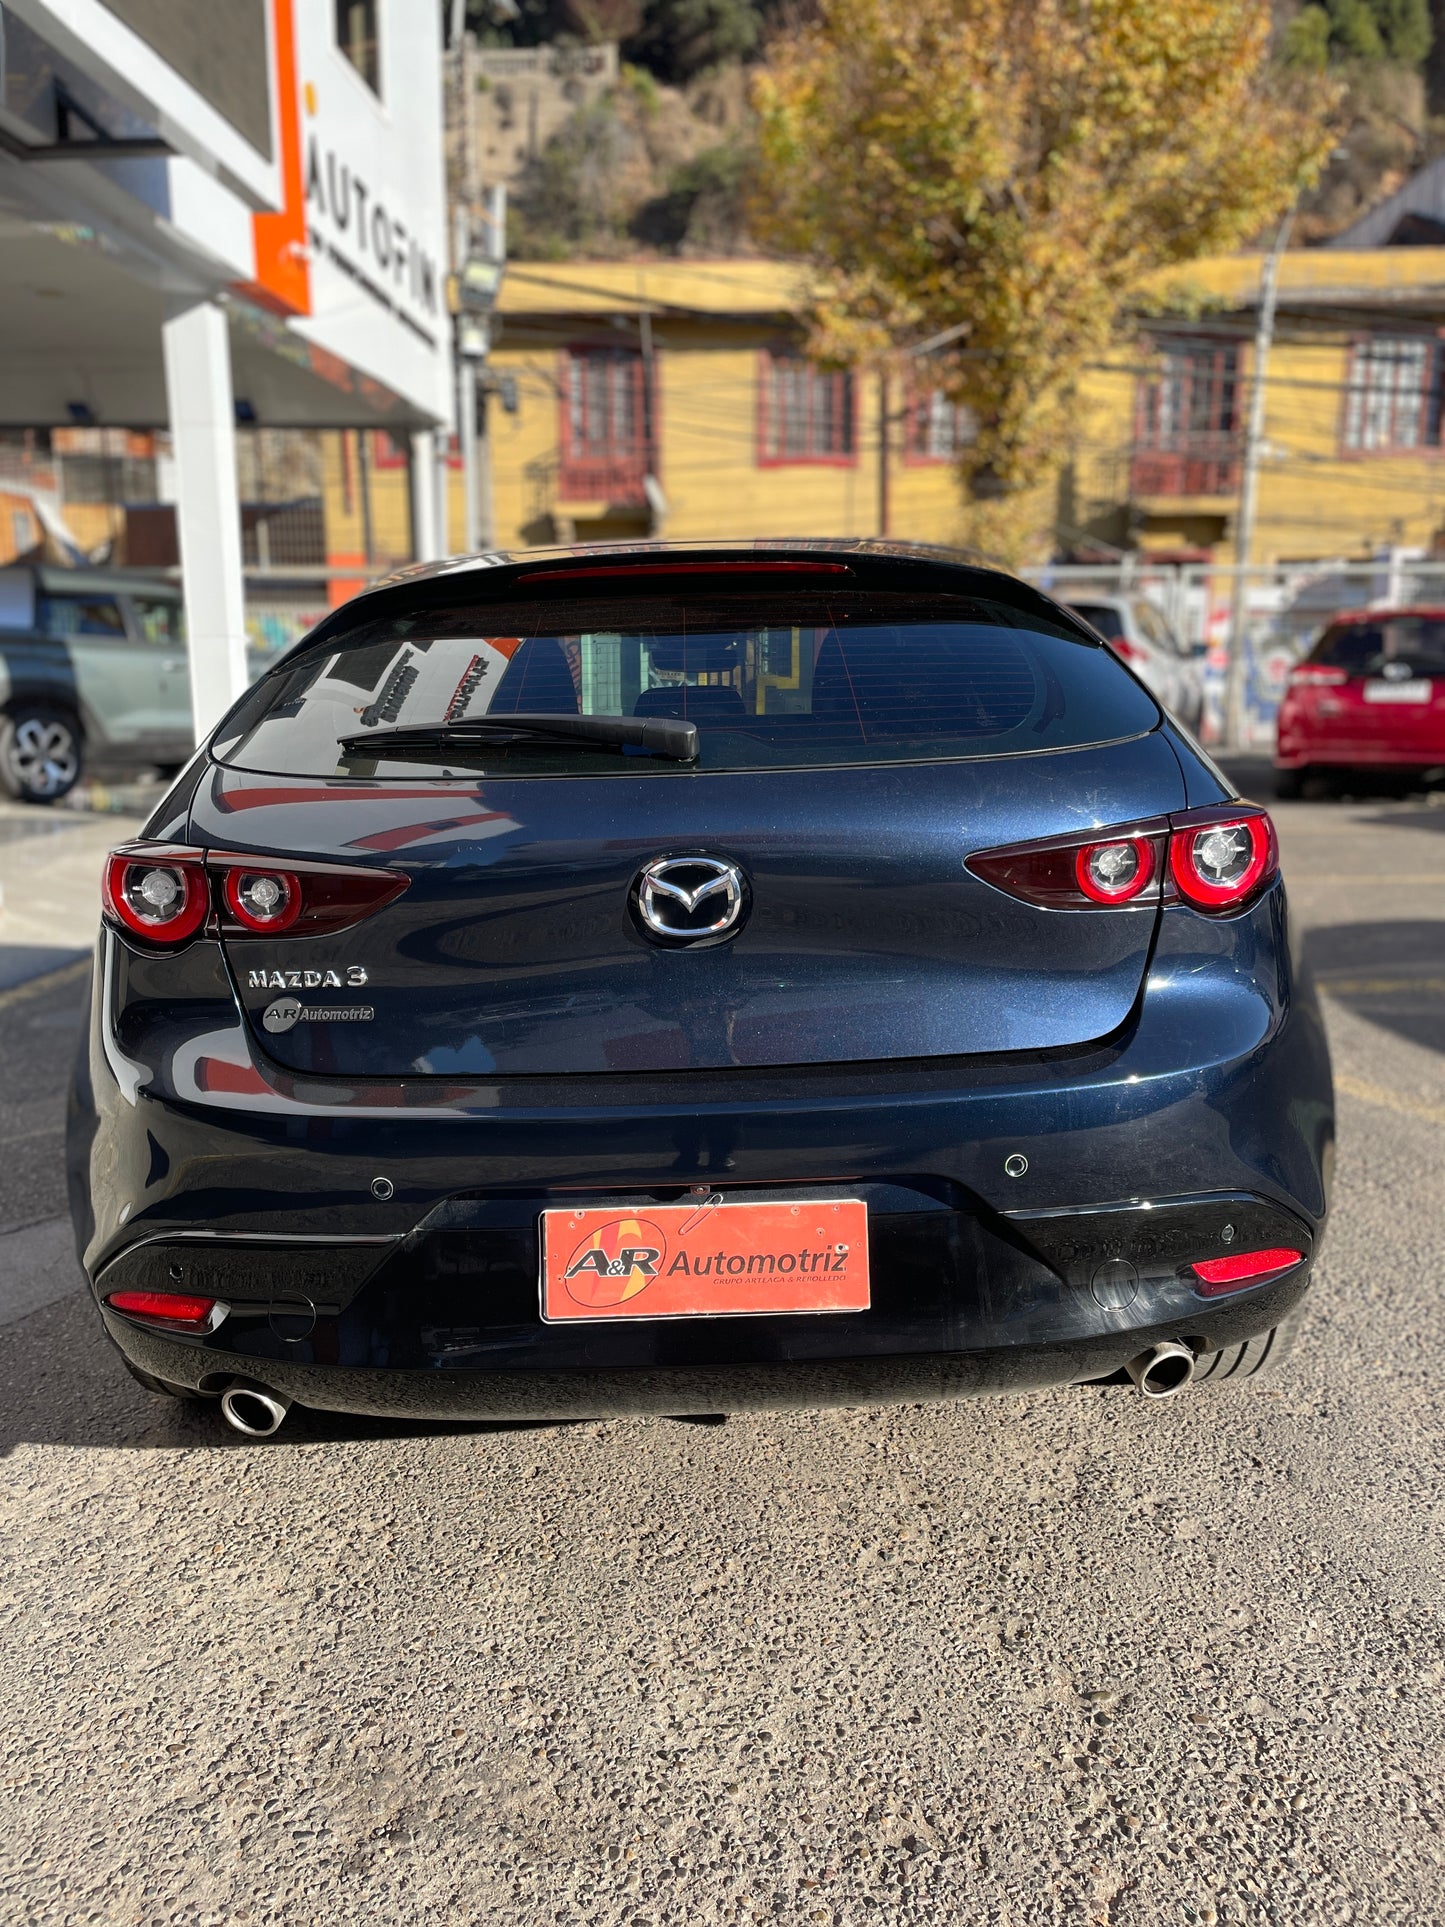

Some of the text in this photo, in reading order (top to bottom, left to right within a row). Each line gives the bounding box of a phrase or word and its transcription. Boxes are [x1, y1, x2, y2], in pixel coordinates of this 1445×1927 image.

[305, 135, 438, 318] AUTOFIN
[248, 965, 369, 989] MAZDA 3
[264, 1007, 372, 1021] AR Automotriz
[563, 1244, 849, 1279] A&R Automotriz
[712, 1277, 744, 1286] GRUPO
